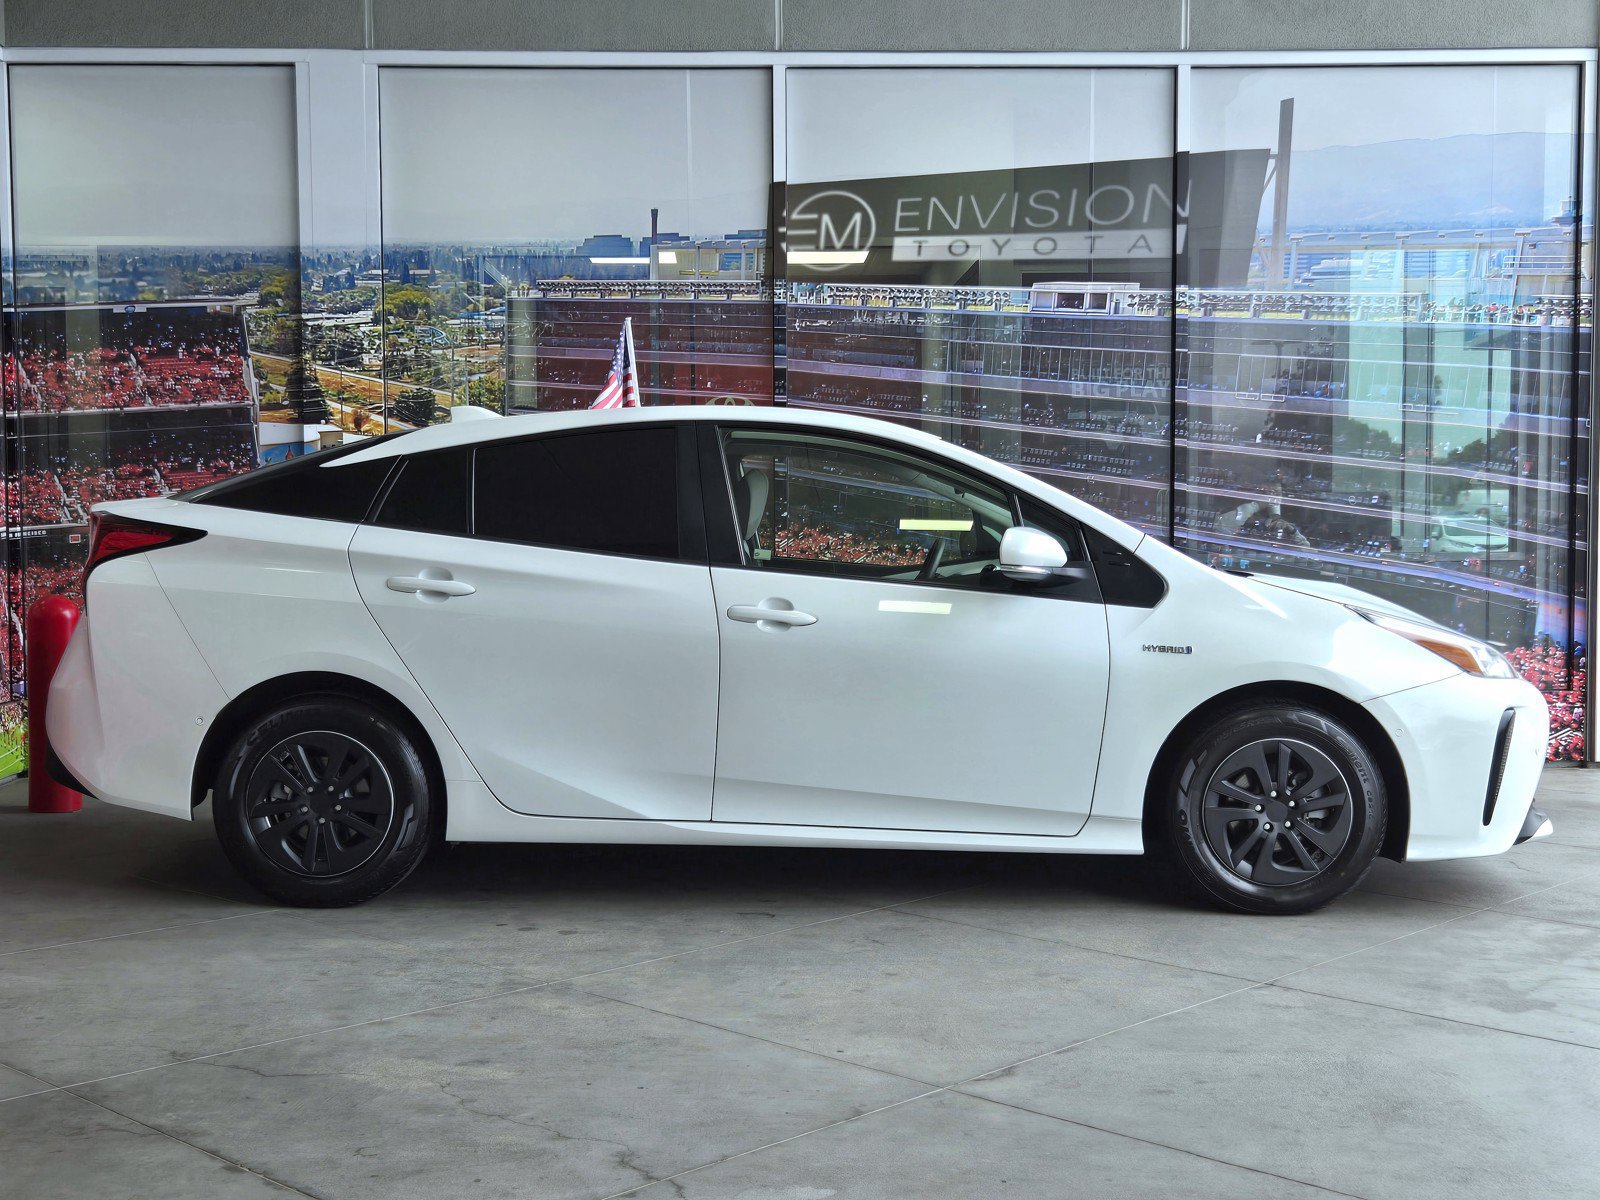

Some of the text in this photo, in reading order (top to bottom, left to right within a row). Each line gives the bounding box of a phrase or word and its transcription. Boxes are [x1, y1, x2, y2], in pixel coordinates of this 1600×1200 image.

[894, 179, 1192, 232] ENVISION
[912, 233, 1153, 258] TOYOTA
[1113, 367, 1143, 380] FOR
[1071, 380, 1110, 398] BIG
[1142, 644, 1185, 654] HYBRID
